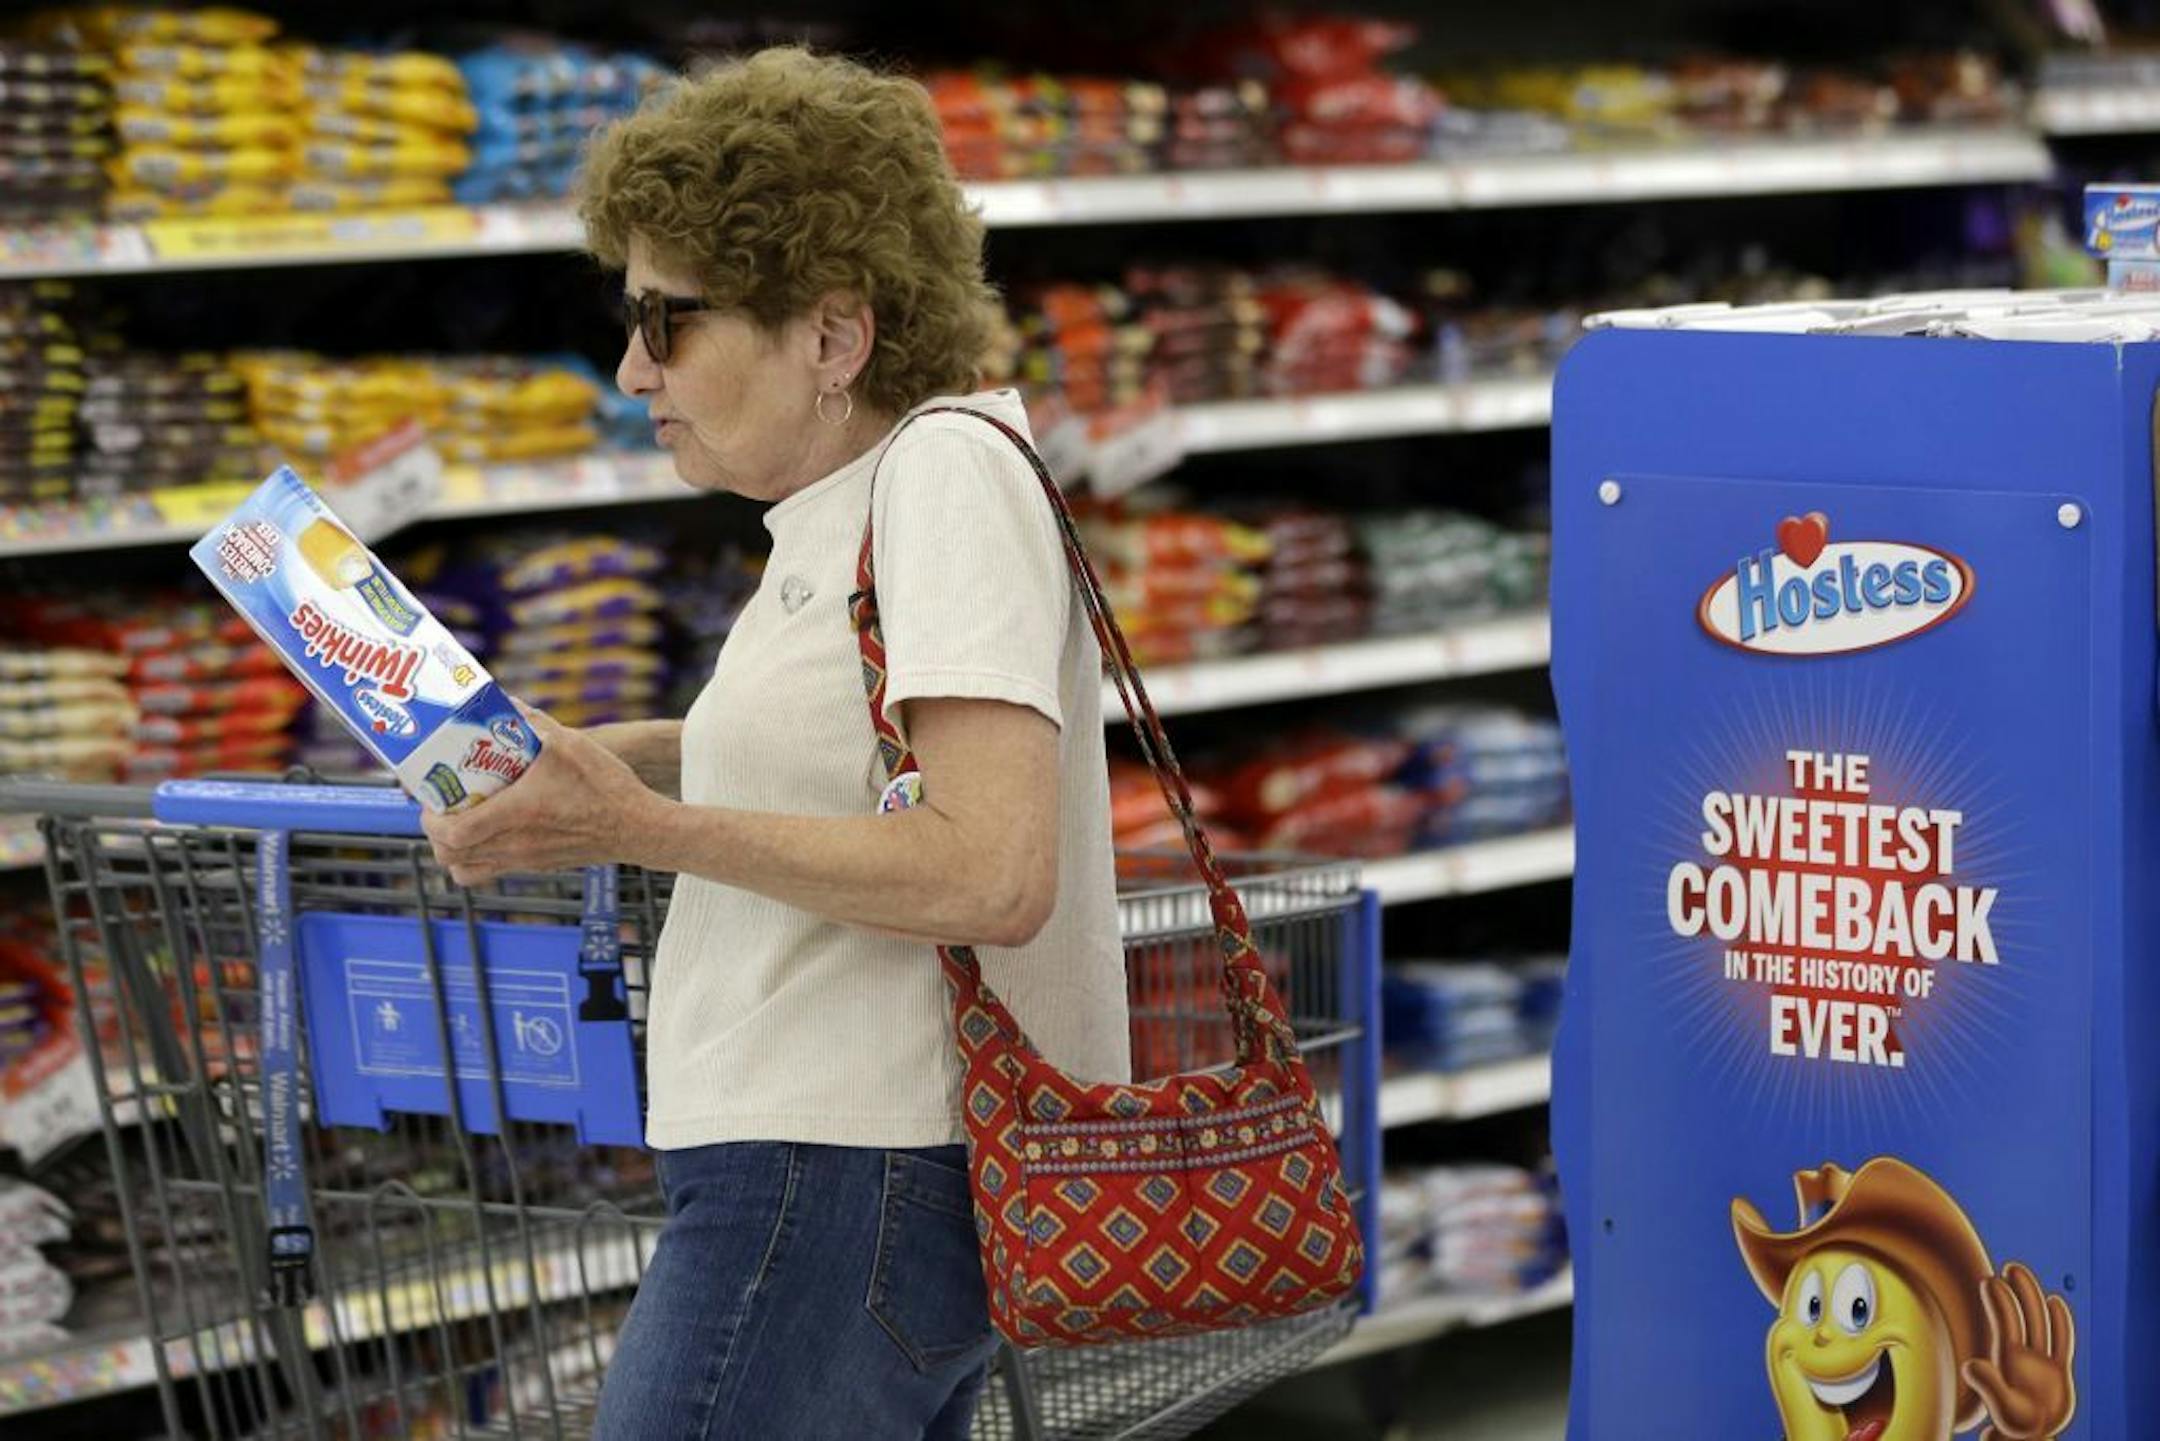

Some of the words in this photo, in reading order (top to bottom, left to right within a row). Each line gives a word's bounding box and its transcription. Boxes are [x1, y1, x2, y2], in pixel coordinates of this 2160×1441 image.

[1737, 548, 1951, 642] Hostess
[292, 602, 419, 698] Twinkies
[359, 690, 411, 733] Hostess
[1787, 750, 1871, 795] THE
[263, 832, 280, 914] Walmart
[1702, 791, 1963, 876] SWEETEST
[1667, 862, 2000, 966] COMEBACK
[1724, 950, 1749, 980] IN
[1752, 952, 1796, 985] THE
[1801, 957, 1900, 996] HISTORY
[1904, 967, 1936, 999] OF
[270, 1072, 291, 1151] Walmart
